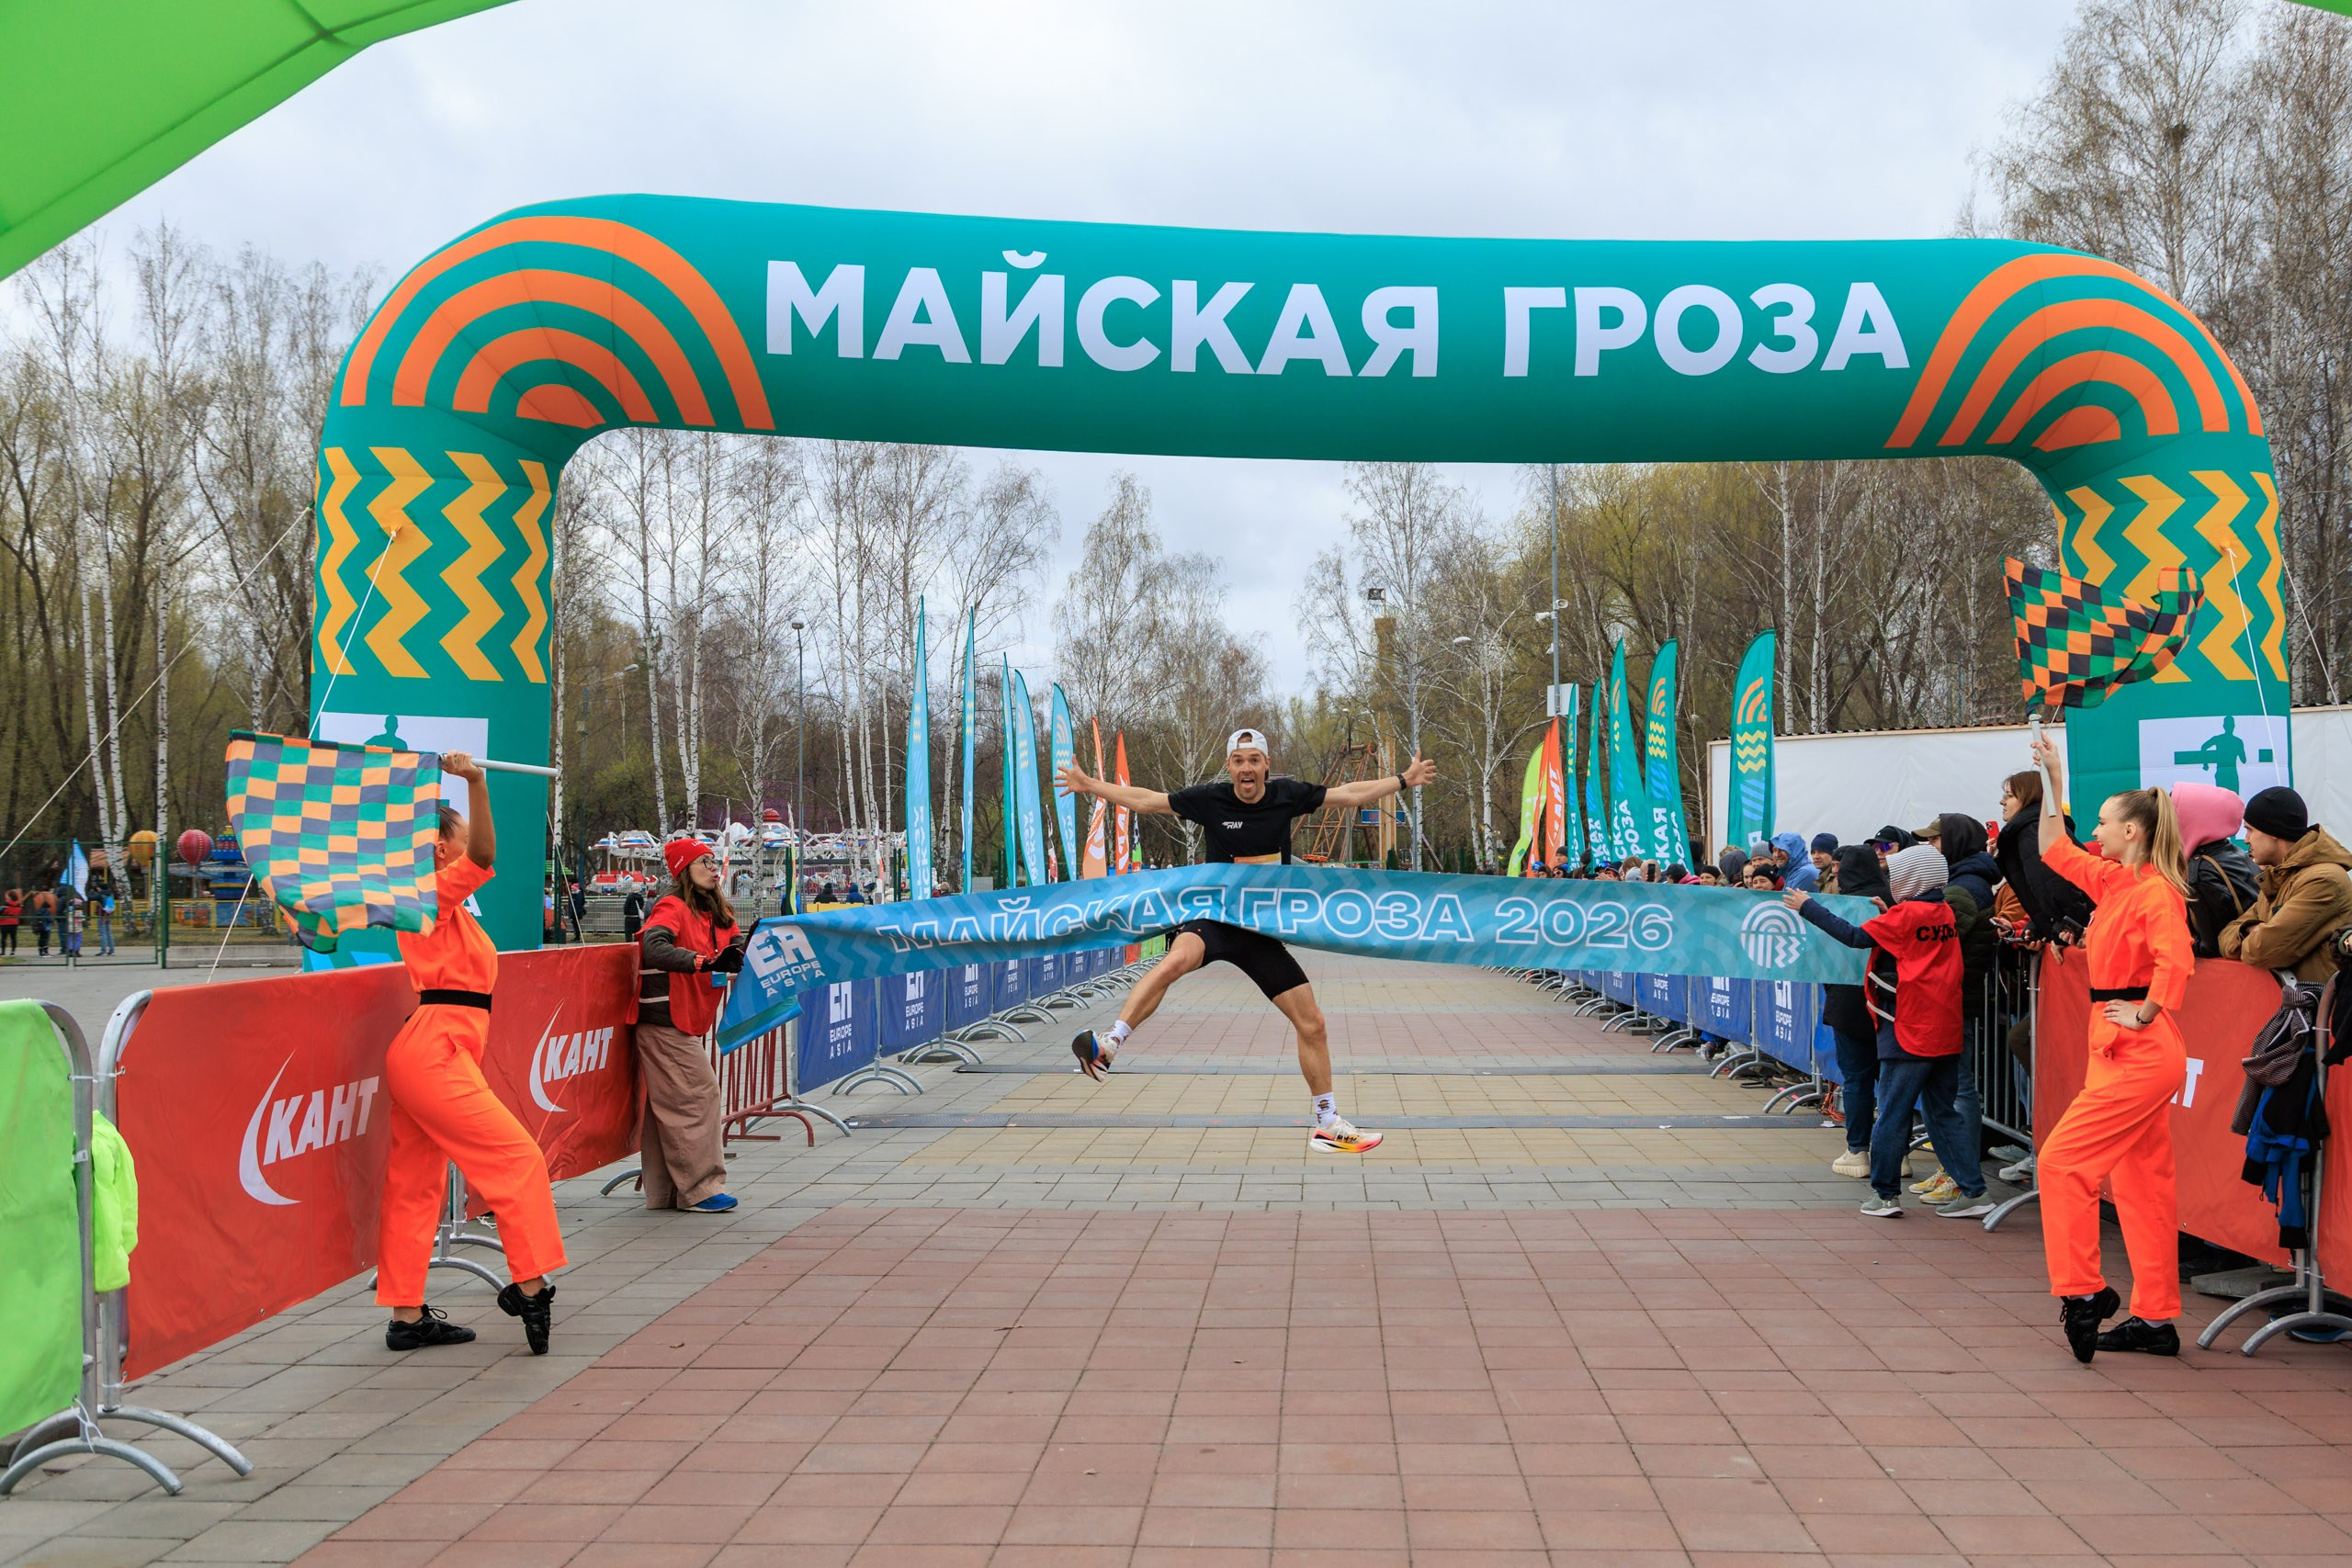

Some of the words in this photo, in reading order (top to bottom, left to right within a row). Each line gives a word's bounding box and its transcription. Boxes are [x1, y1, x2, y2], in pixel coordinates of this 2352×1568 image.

[765, 250, 1439, 378] МАЙСКАЯ
[1503, 282, 1911, 378] ГРОЗА
[876, 886, 1226, 953] МАЙСКАЯ
[1239, 886, 1474, 942] ГРОЗА
[1495, 897, 1674, 951] 2026
[760, 960, 821, 989] EUROPE
[766, 969, 826, 998] ASIA
[965, 984, 978, 997] EUROPE
[905, 1002, 924, 1018] EUROPE
[965, 995, 978, 1009] ASIA
[830, 1023, 852, 1043] EUROPE
[905, 1016, 924, 1032] ASIA
[1775, 1025, 1792, 1043] ASIA
[544, 1026, 615, 1083] КАНТ
[830, 1039, 852, 1060] ASIA
[263, 1076, 379, 1166] КАНТ
